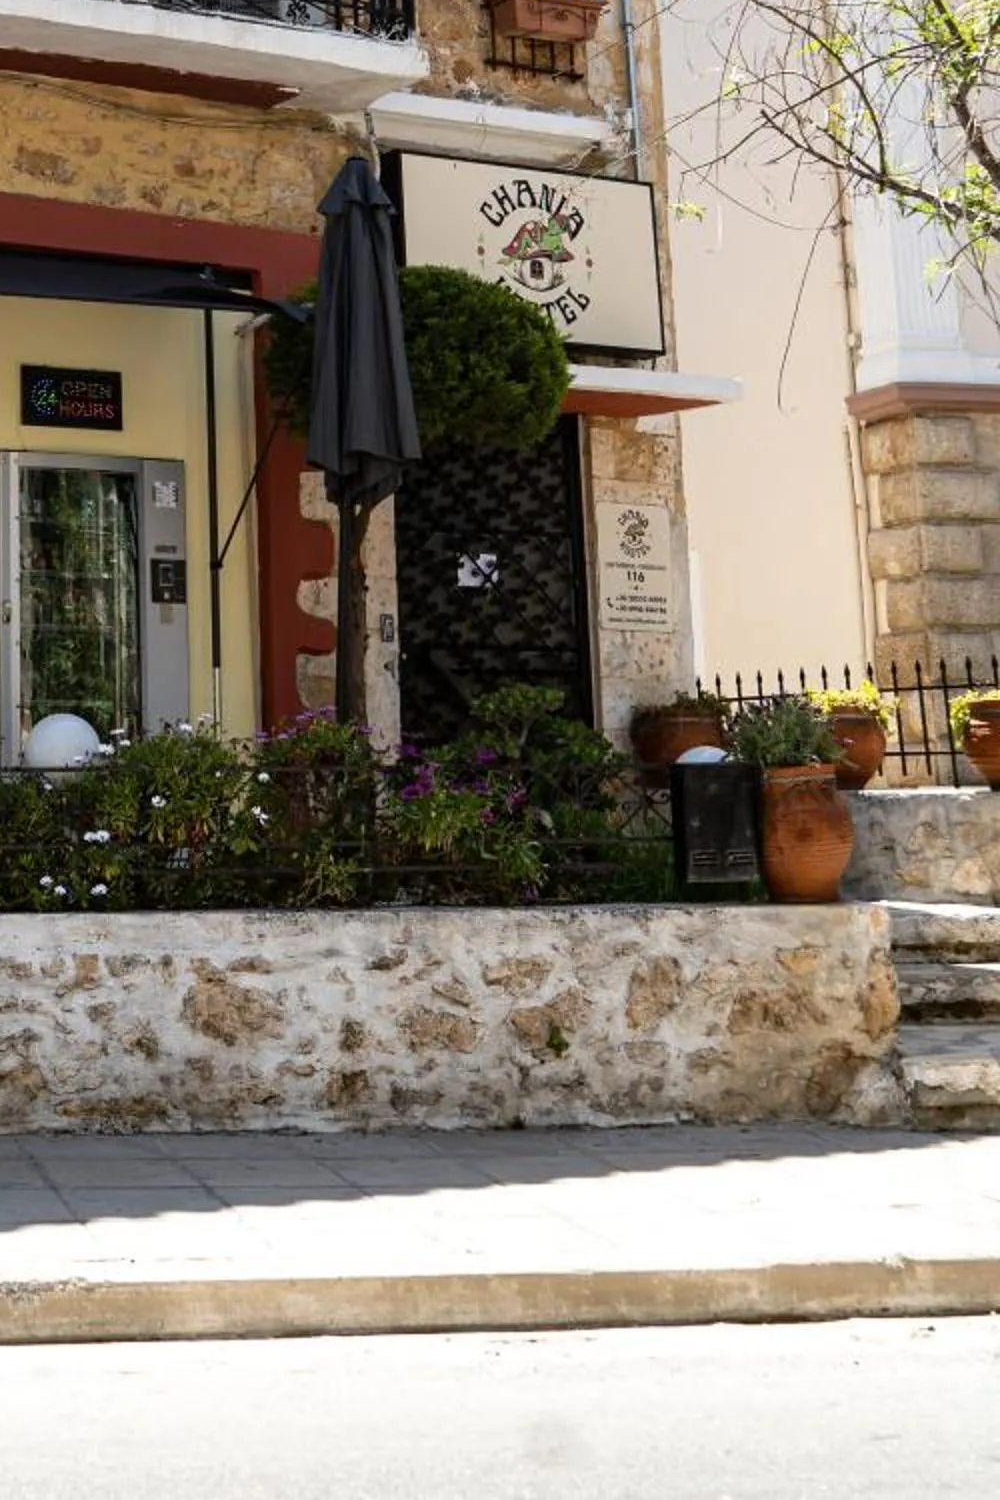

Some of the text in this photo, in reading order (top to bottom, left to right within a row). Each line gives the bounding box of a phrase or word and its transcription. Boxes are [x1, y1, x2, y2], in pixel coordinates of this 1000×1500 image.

[479, 179, 585, 241] CHANIA
[496, 276, 591, 325] TEL
[61, 380, 113, 399] OPEN
[59, 401, 115, 419] HOURS
[627, 571, 645, 583] 116
